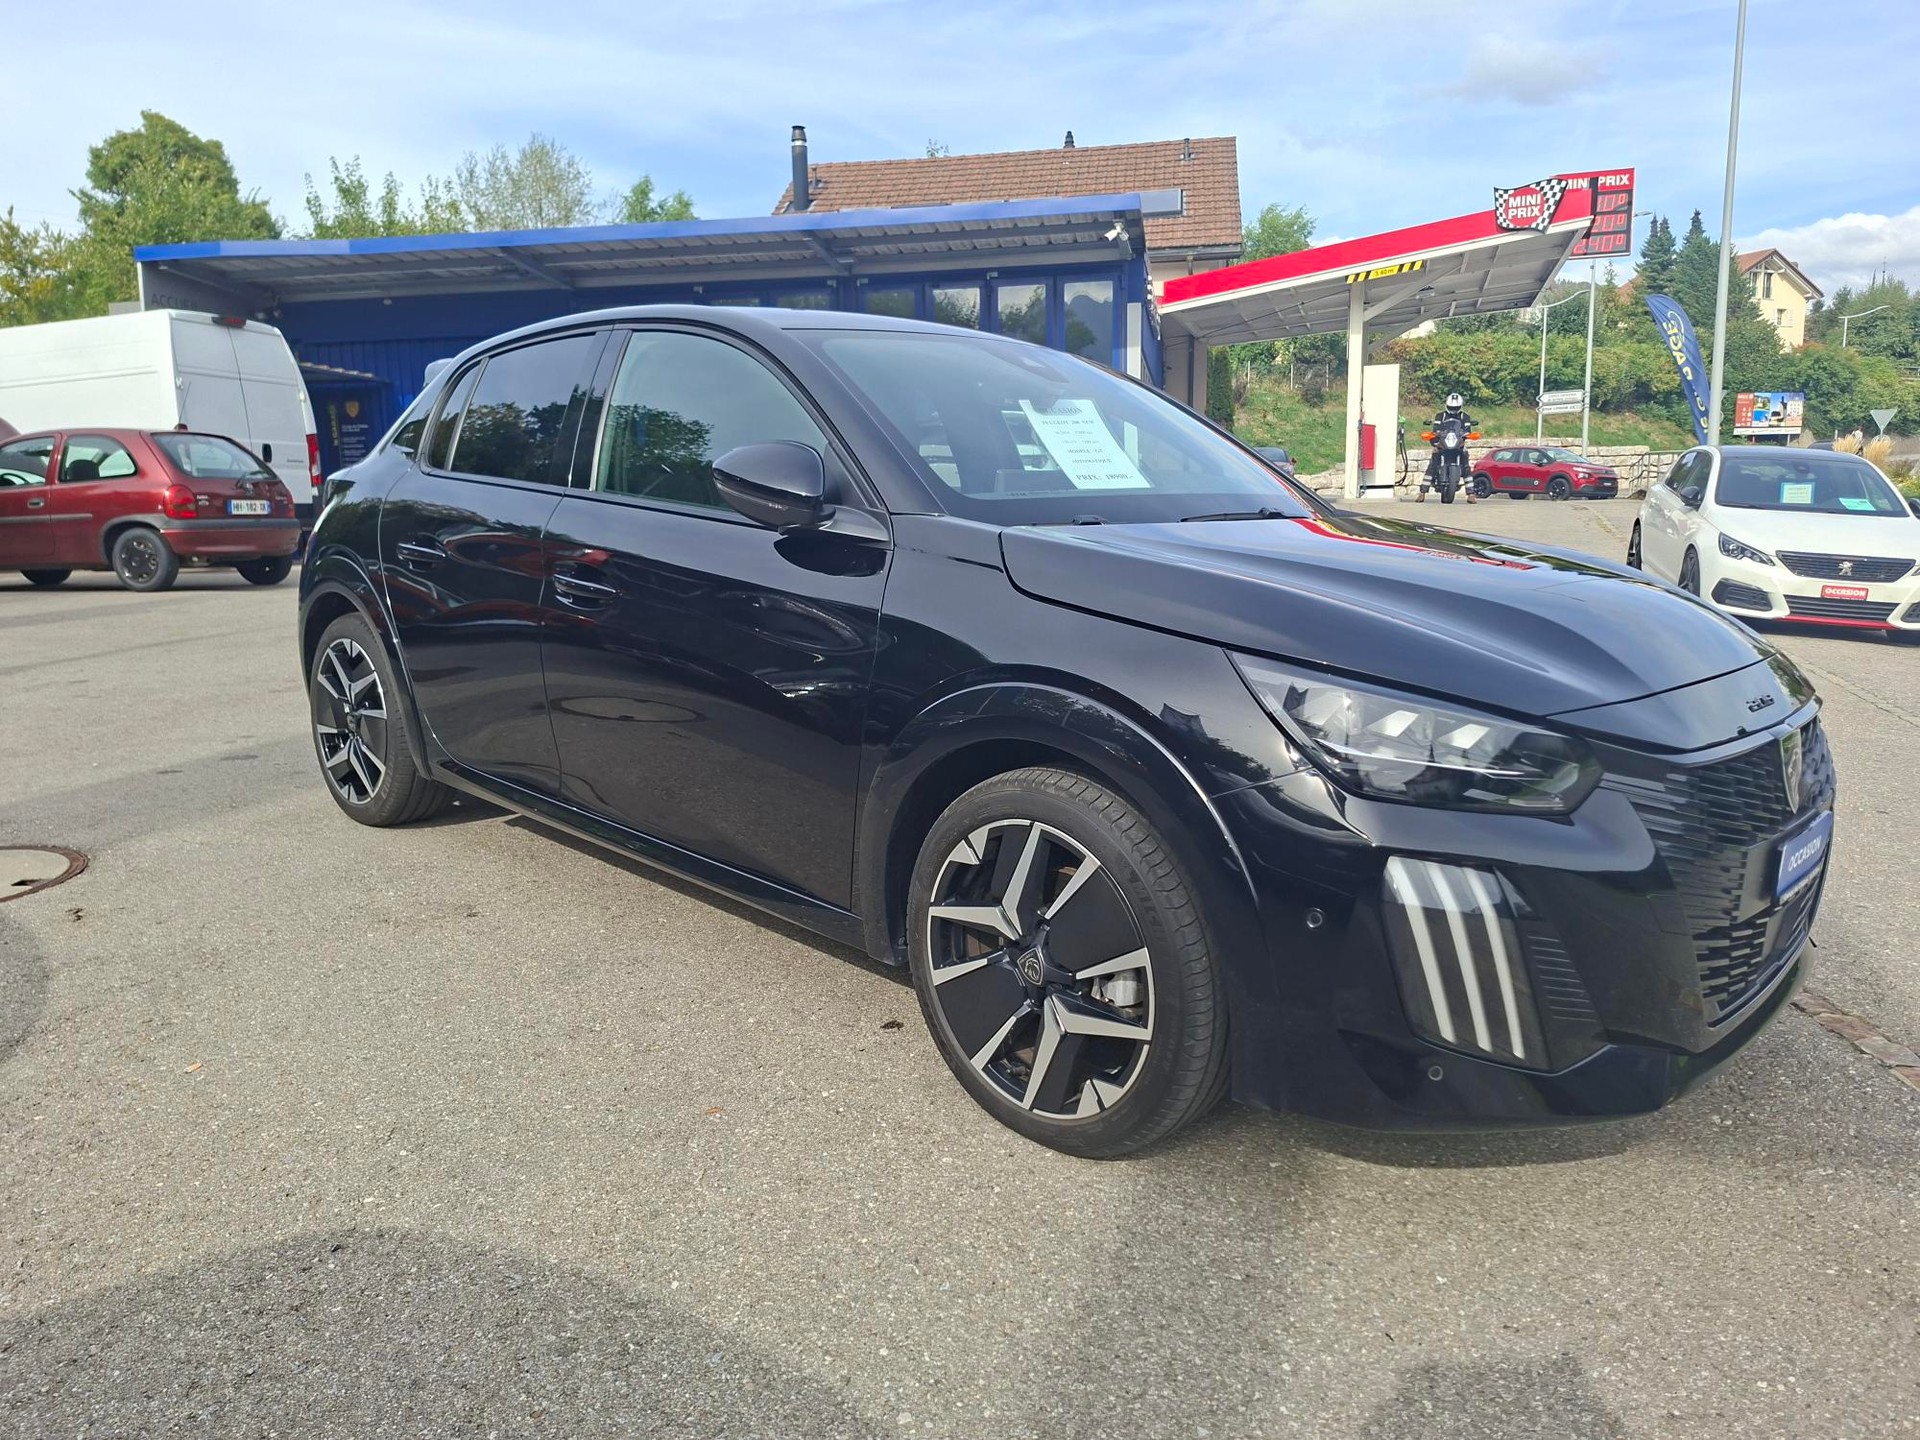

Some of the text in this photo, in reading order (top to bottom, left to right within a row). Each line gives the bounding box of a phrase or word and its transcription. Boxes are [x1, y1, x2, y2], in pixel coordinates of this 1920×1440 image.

[1597, 174, 1629, 187] PRIX
[1508, 194, 1541, 208] MINI
[1508, 206, 1541, 220] PRIX
[1825, 587, 1866, 597] OCCASION
[1788, 835, 1822, 872] OCCASION
